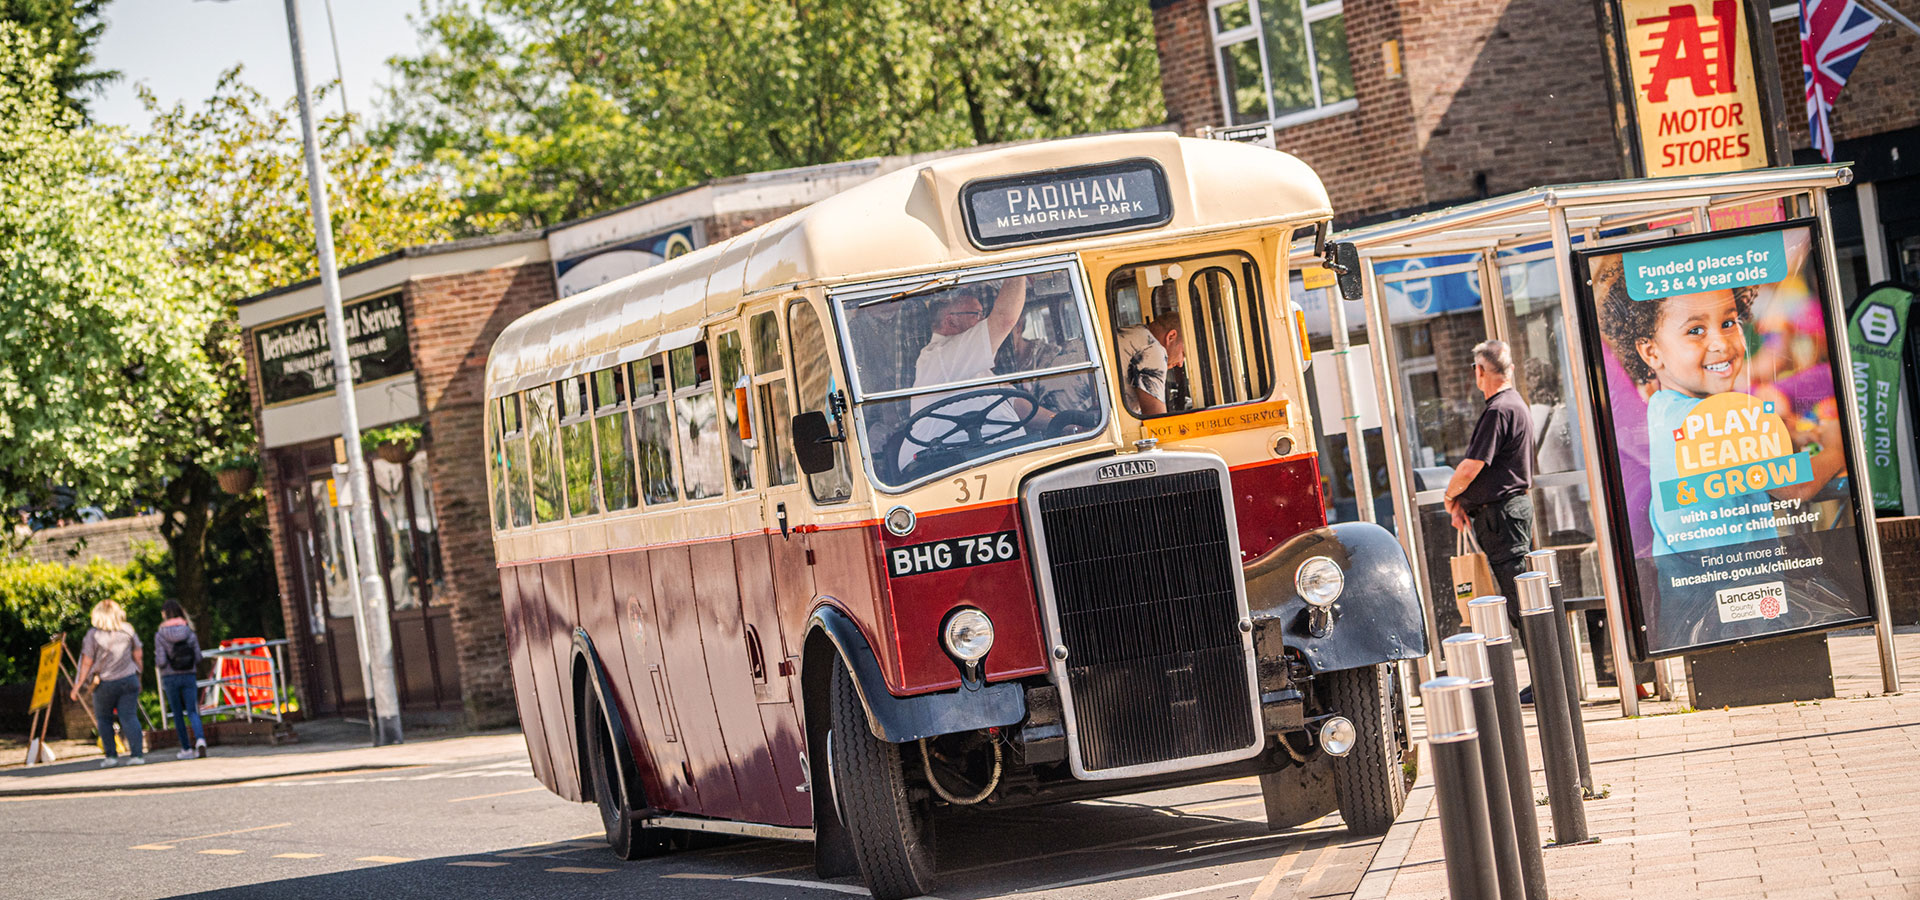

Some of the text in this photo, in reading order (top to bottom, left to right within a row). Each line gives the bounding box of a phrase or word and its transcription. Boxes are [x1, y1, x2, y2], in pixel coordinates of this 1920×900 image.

[1658, 102, 1743, 137] MOTOR
[1661, 133, 1750, 168] STORES
[1006, 177, 1127, 213] PADIHAM
[996, 201, 1144, 228] MEMORIAL PARK
[1638, 250, 1769, 279] Funded places for
[1645, 266, 1768, 295] 2, 3 & 4 year olds
[360, 301, 402, 335] Service
[1150, 408, 1286, 437] NOT IN PUBLIC SERVICE
[1686, 406, 1770, 440] PLAY,
[1875, 380, 1890, 467] ELECTRIC
[1681, 432, 1781, 470] LEARN
[1099, 461, 1156, 480] LEYLAND
[1676, 457, 1797, 505] & GROW
[952, 474, 988, 504] 37
[1680, 497, 1801, 524] with a local nursery
[1666, 511, 1821, 545] preschool or childminder
[893, 534, 1014, 575] BHG 756
[1701, 545, 1788, 567] Find out more at:
[1671, 556, 1824, 588] lancashire.gov.uk/childcare
[1719, 585, 1783, 605] Lancashire
[1729, 603, 1754, 613] County
[1731, 609, 1756, 619] Council
